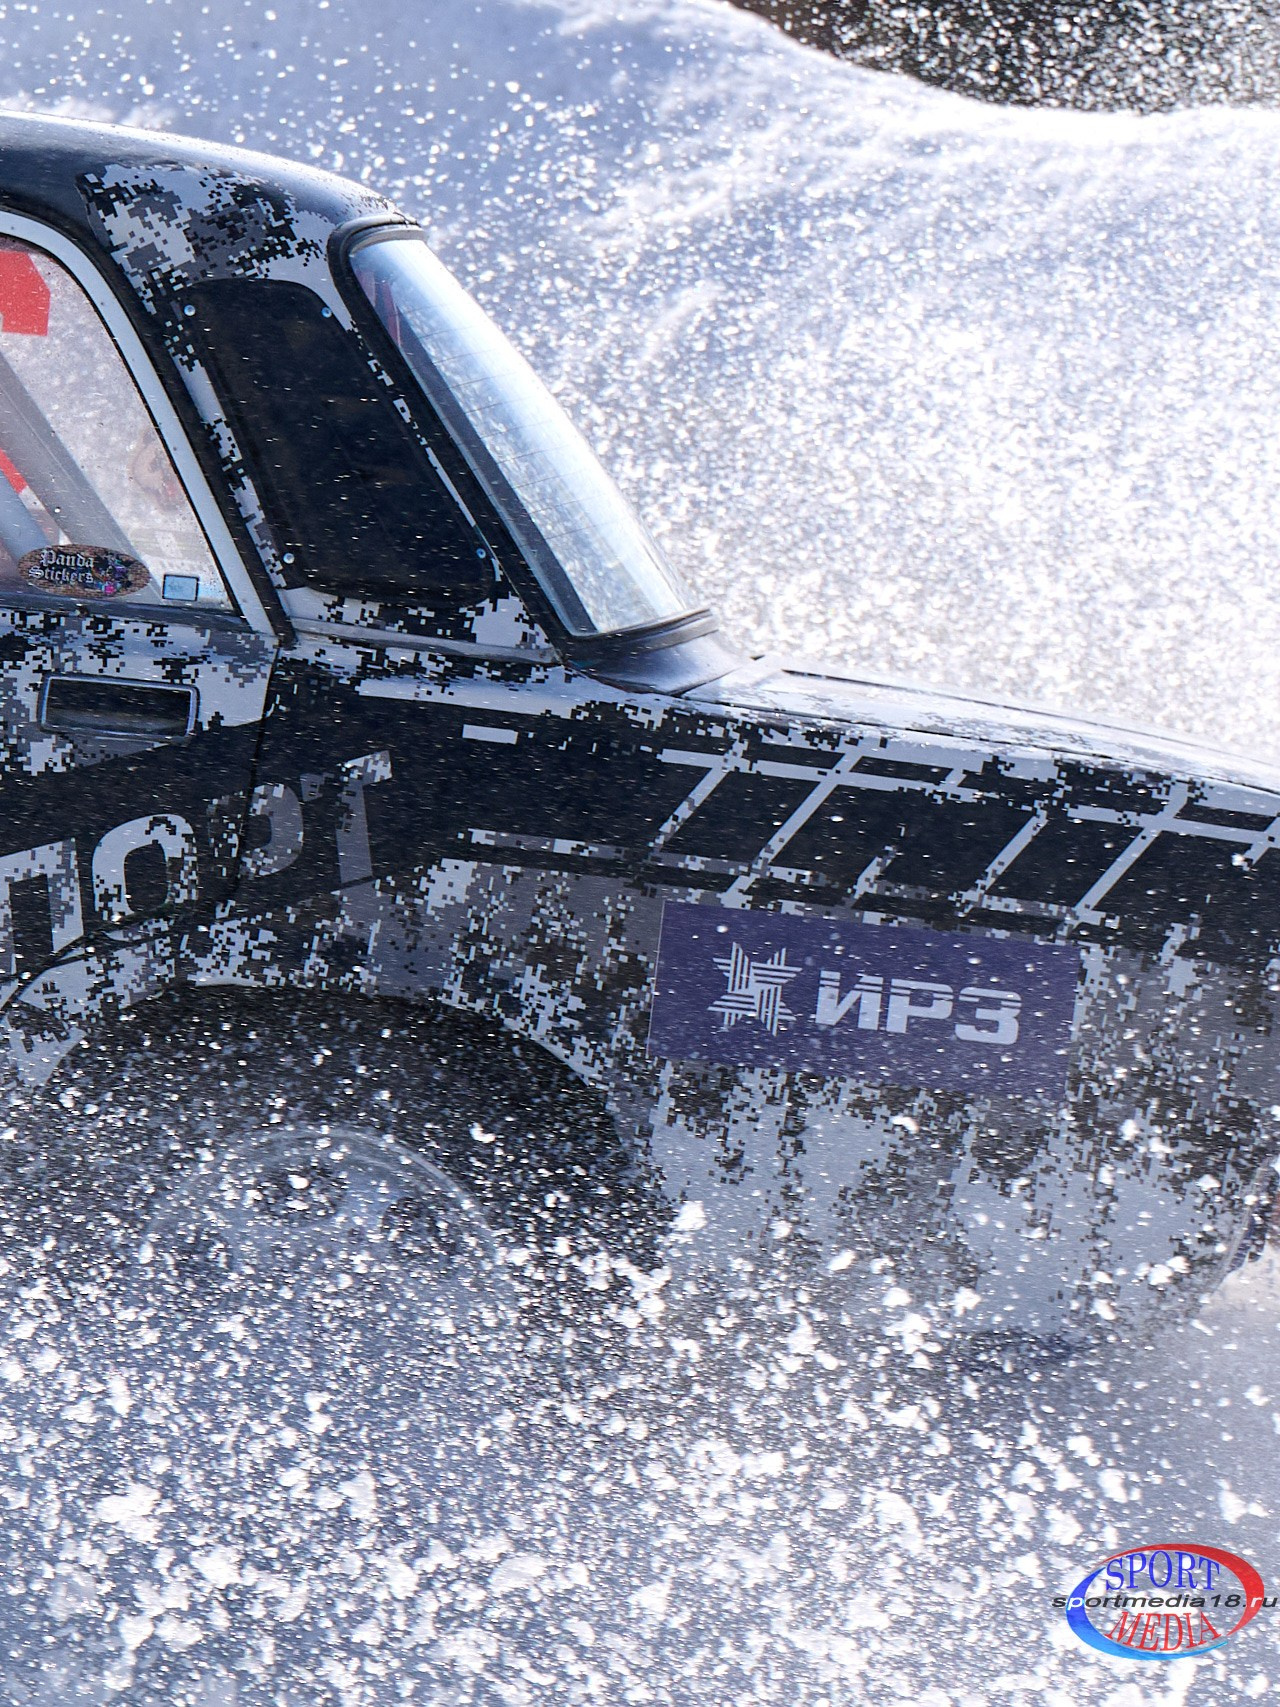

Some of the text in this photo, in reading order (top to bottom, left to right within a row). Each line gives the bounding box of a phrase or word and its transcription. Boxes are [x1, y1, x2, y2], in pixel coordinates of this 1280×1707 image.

[40, 549, 95, 568] Panda
[28, 564, 94, 584] Stickers
[815, 970, 1021, 1044] ИРЗ
